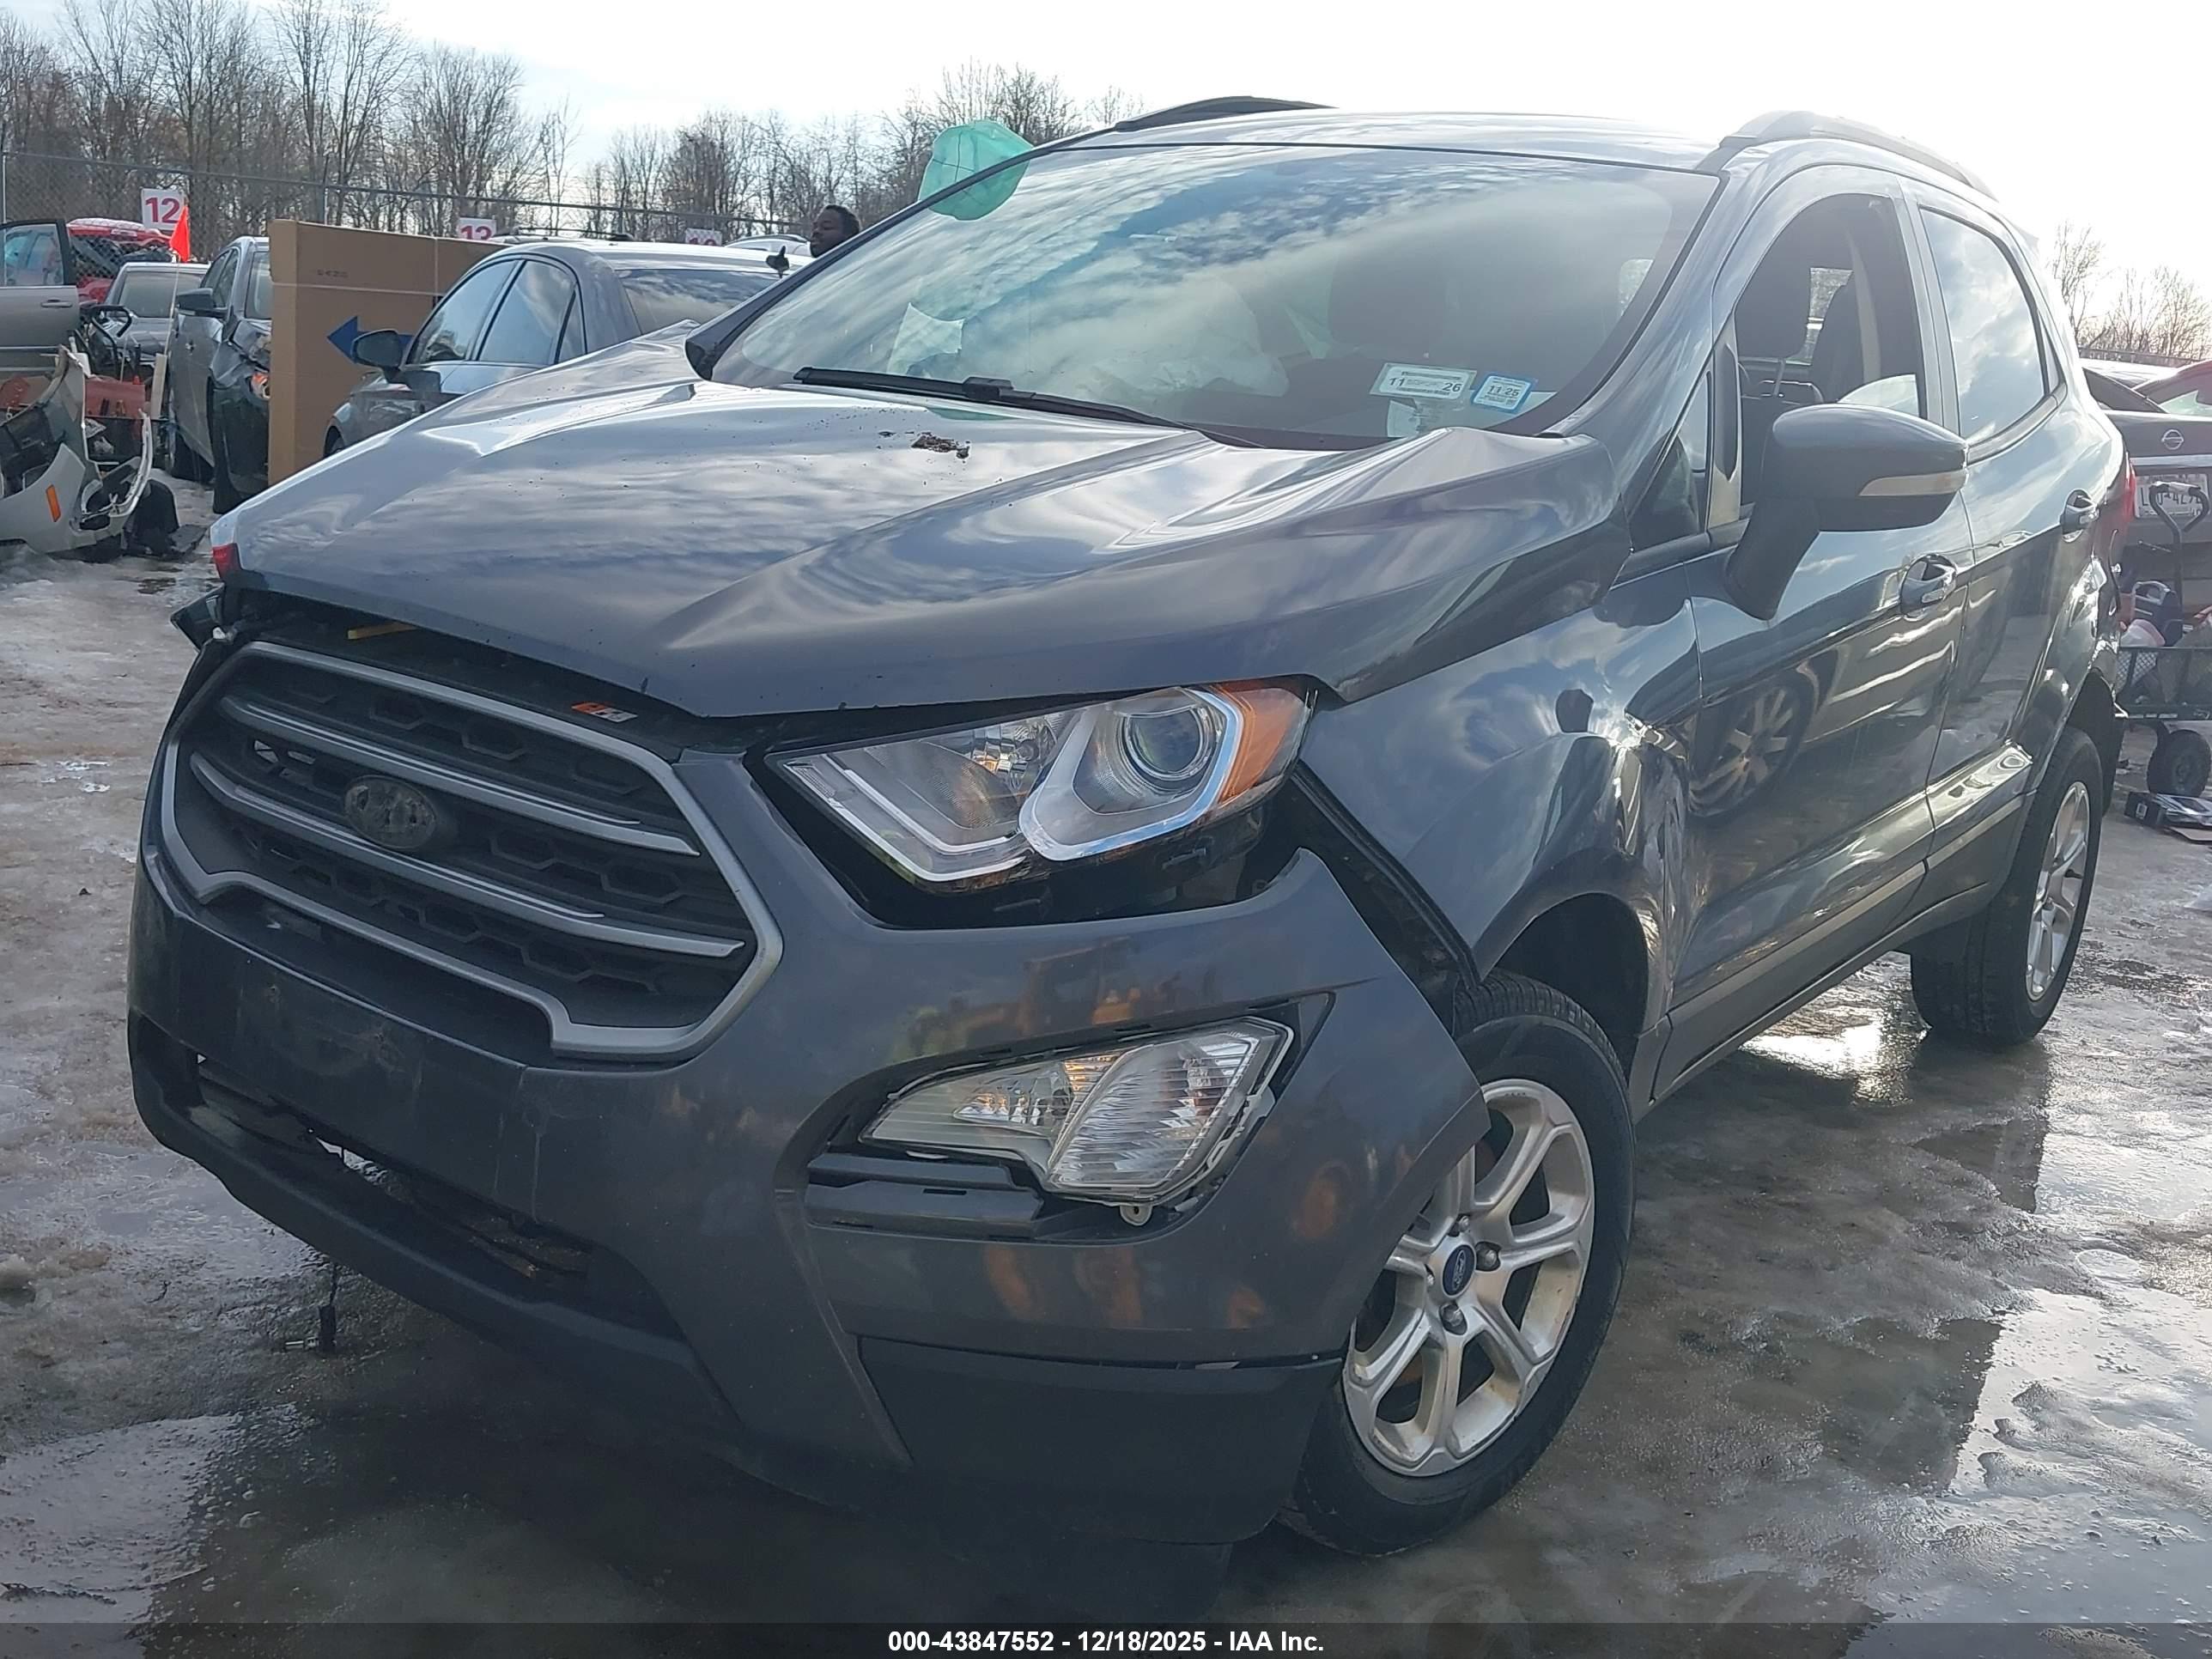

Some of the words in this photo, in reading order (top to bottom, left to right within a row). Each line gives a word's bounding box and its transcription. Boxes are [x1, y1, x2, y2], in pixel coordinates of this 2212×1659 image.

[145, 197, 180, 223] 12
[1389, 378, 1406, 386] 11
[1443, 382, 1463, 392] 26
